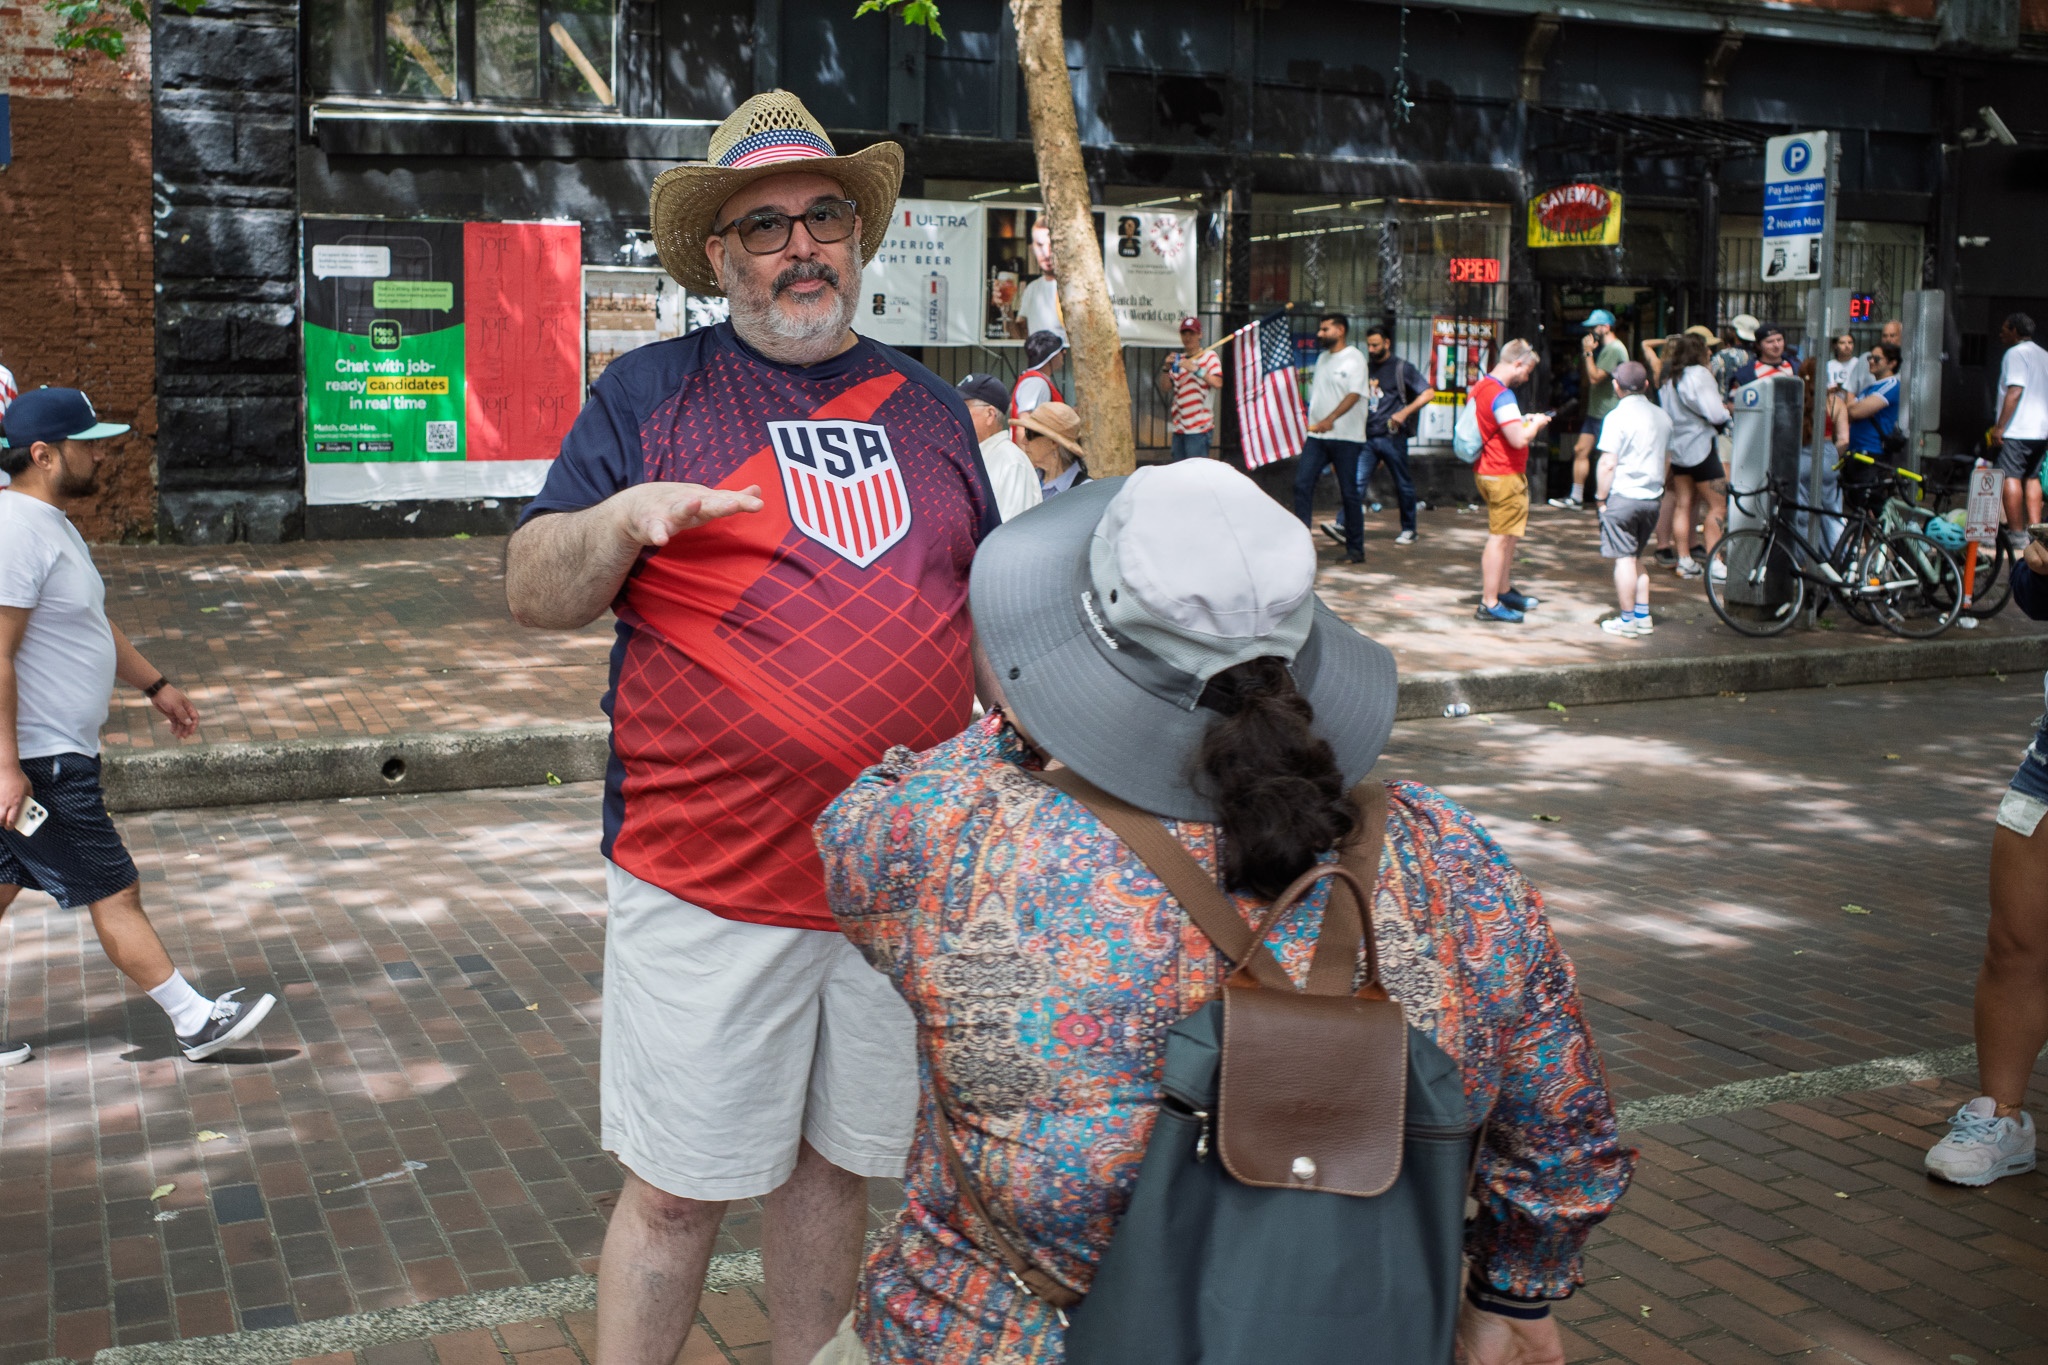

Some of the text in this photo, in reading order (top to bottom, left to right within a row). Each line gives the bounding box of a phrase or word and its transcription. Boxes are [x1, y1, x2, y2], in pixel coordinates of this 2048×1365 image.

[1768, 182, 1823, 196] Pay 8am-6pm
[1540, 186, 1608, 214] SAVEWAY
[916, 215, 968, 227] ULTRA
[1767, 216, 1821, 230] 2 Hours Max
[1540, 217, 1610, 242] MARKET
[881, 240, 944, 250] UPERIOR
[916, 256, 952, 265] BEER
[1451, 259, 1498, 281] OPEN
[1139, 295, 1154, 306] the
[929, 299, 938, 340] ULTRA
[1130, 309, 1156, 320] World
[1157, 309, 1176, 324] Cup
[373, 327, 393, 337] Mee
[374, 336, 397, 345] boss
[335, 359, 436, 376] Chat with job-
[326, 378, 445, 394] ready candidates
[350, 396, 427, 410] in real time
[313, 424, 377, 432] Match. Chat. Hire.
[777, 427, 888, 479] USA
